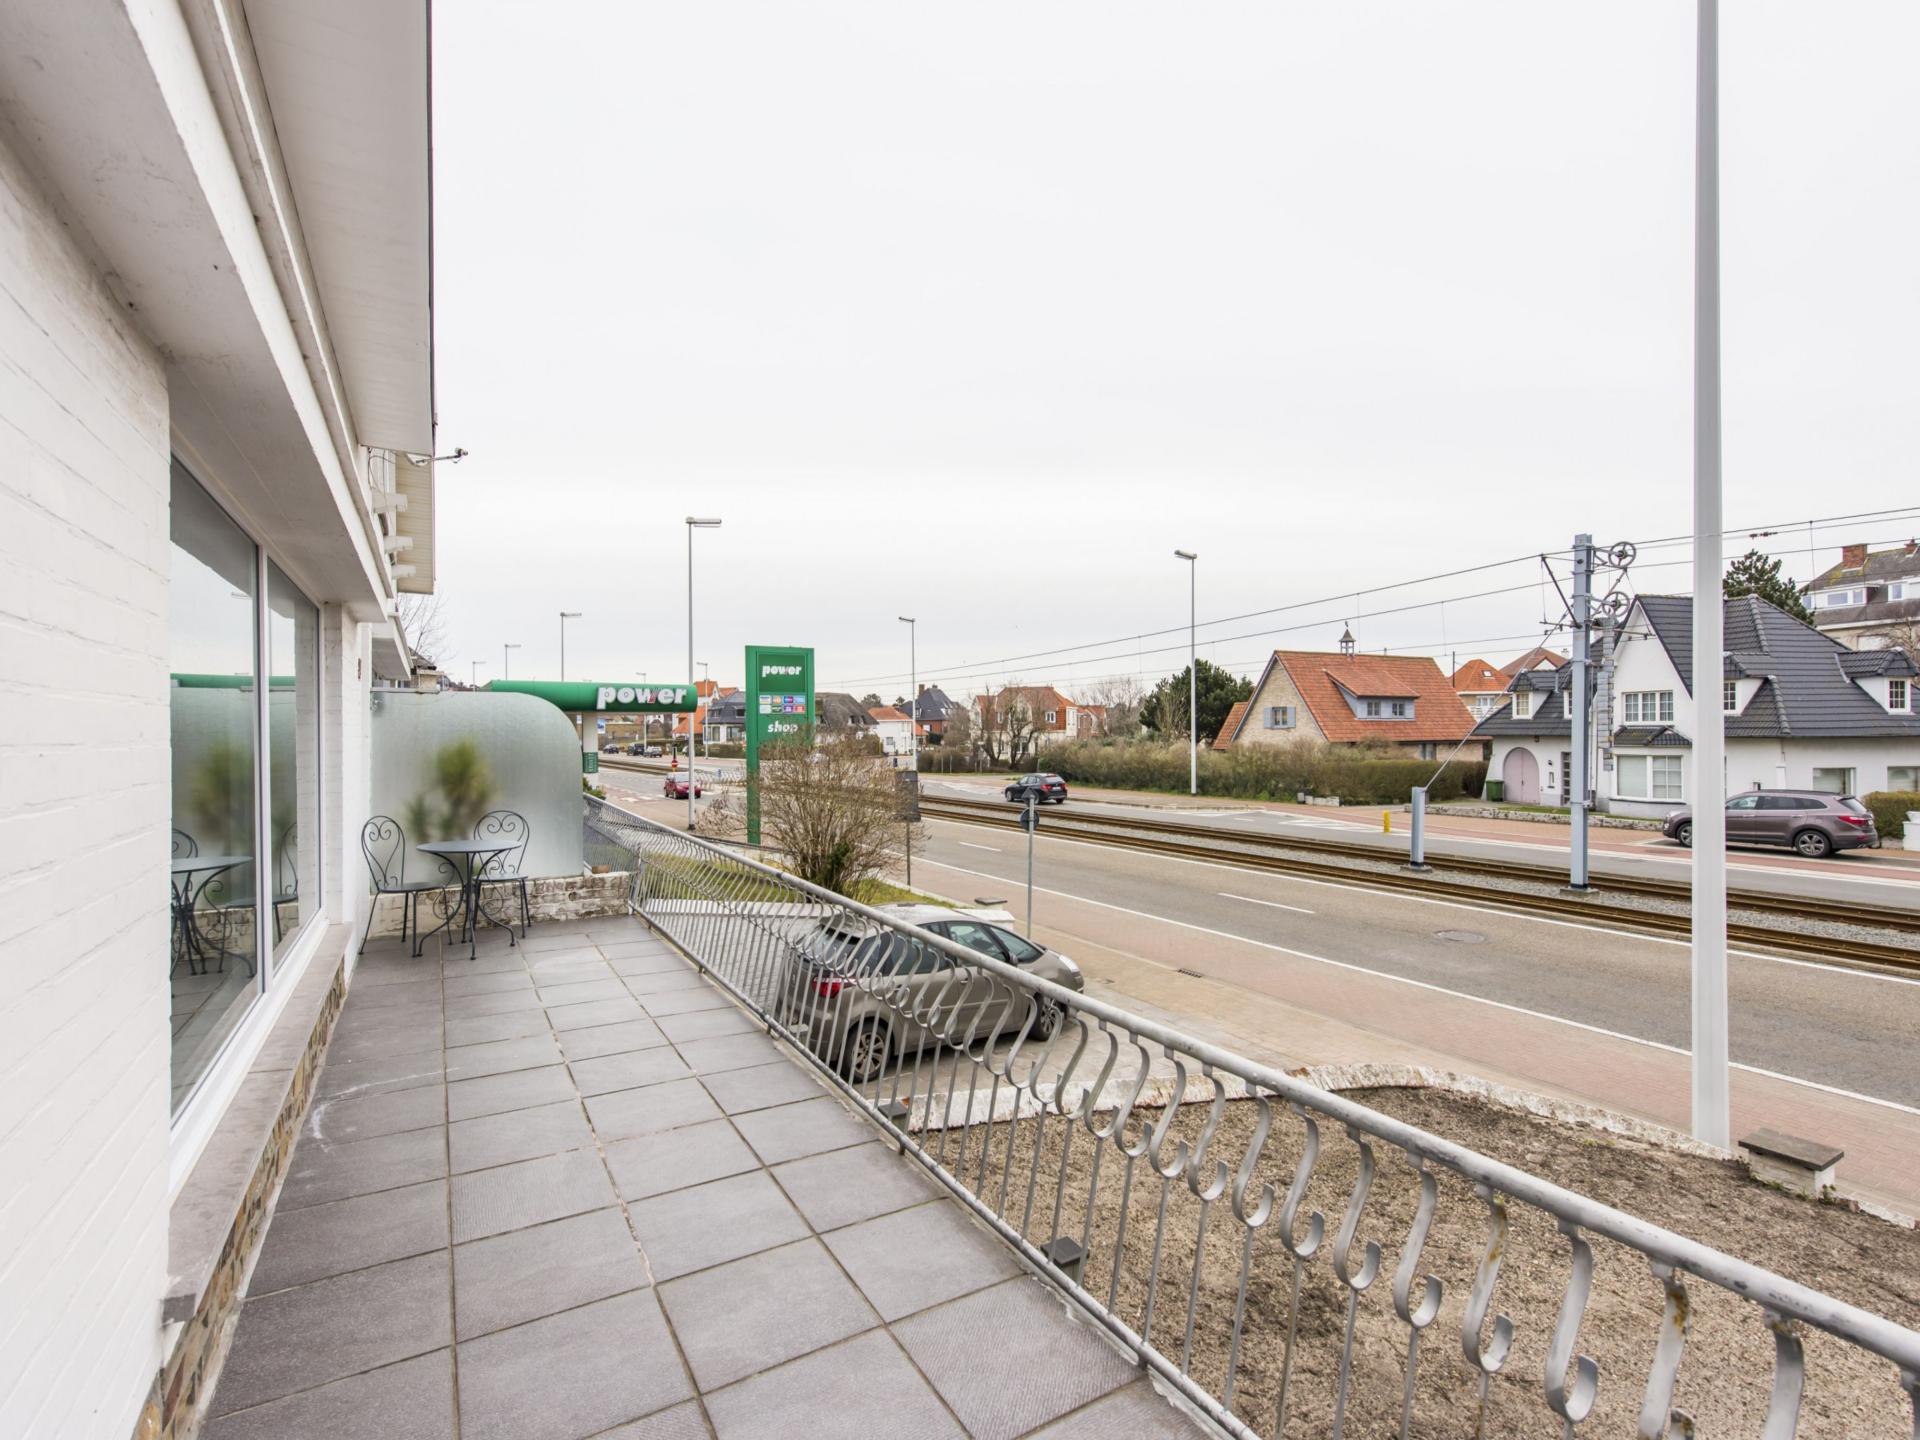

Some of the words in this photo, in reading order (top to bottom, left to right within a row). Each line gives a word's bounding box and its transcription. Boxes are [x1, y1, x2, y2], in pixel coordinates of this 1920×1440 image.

[762, 665, 802, 678] power
[596, 687, 687, 710] power
[767, 720, 799, 735] shop
